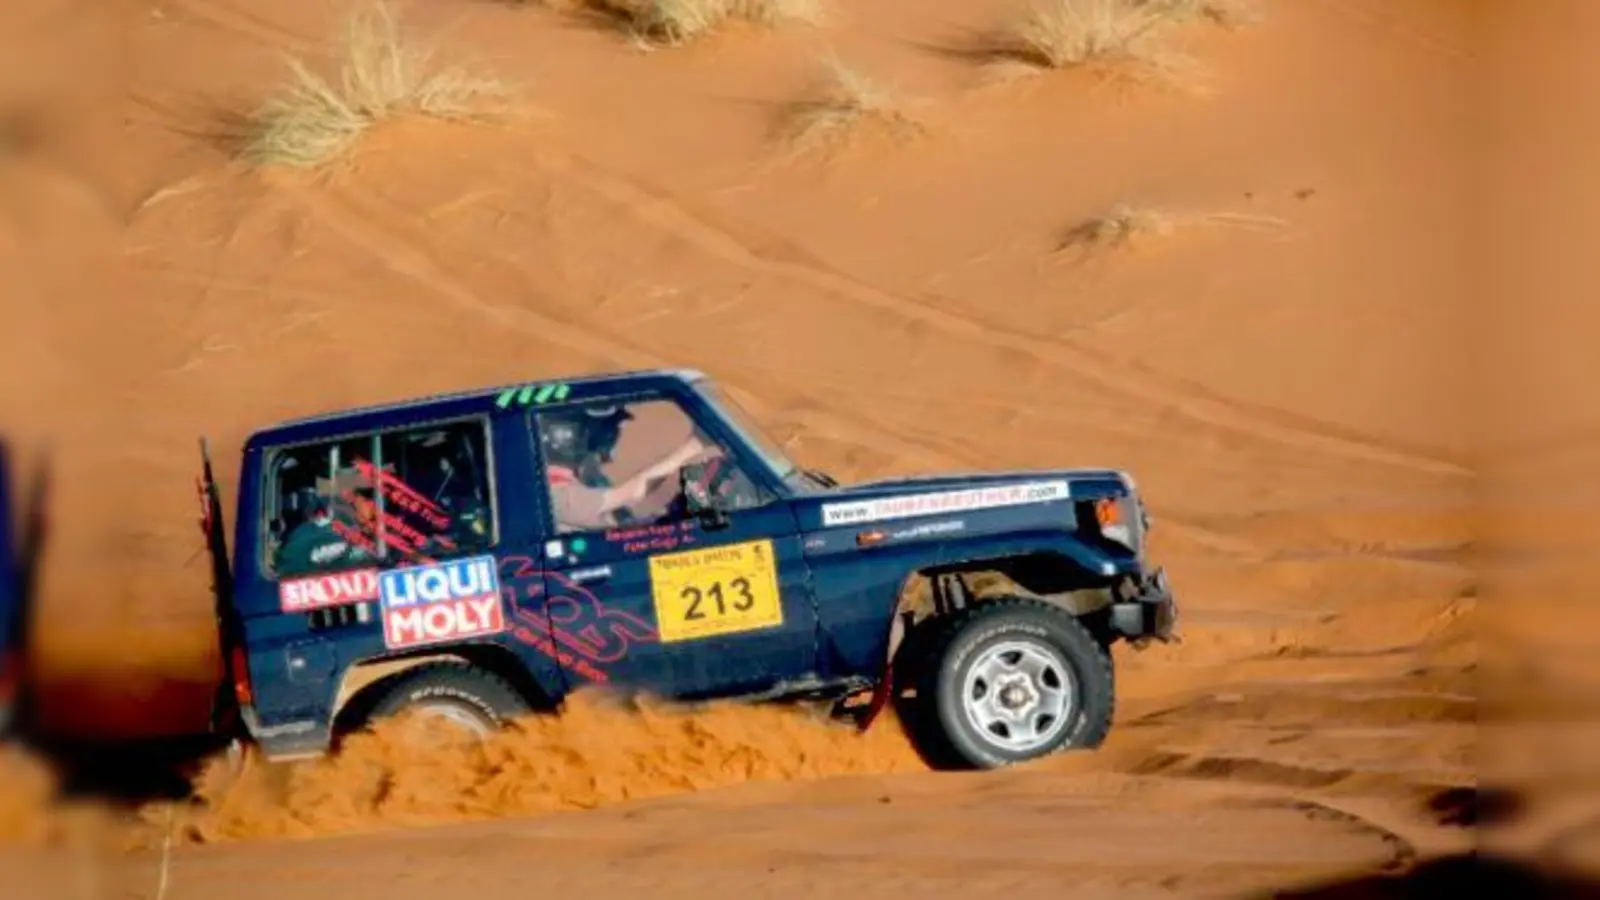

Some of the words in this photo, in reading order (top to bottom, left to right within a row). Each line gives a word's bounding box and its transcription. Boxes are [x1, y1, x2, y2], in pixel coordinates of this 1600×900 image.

[384, 559, 492, 606] LIQUI
[680, 575, 754, 621] 213
[390, 596, 497, 644] MOLY
